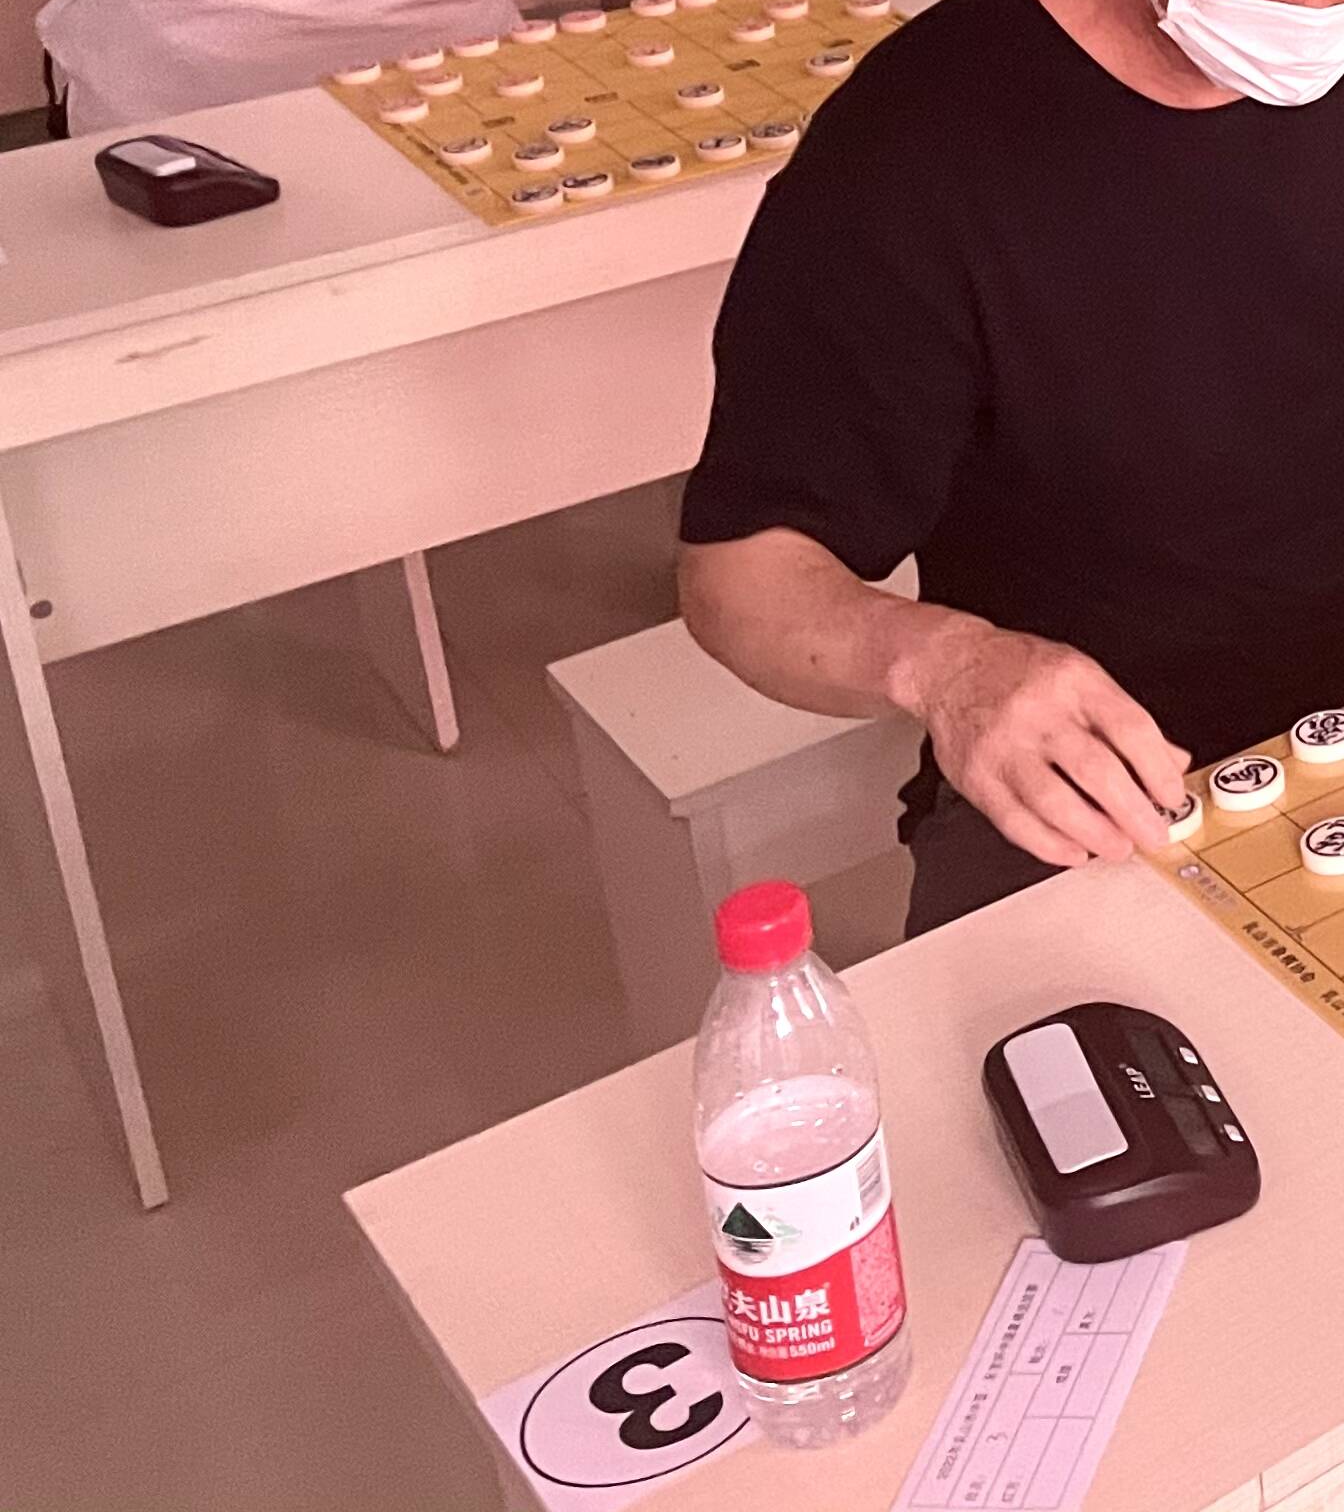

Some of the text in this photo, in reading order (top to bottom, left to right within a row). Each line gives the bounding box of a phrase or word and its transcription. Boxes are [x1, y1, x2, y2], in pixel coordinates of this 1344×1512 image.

[722, 1285, 831, 1325] 夫山泉
[765, 1319, 833, 1345] SPRING
[589, 1341, 724, 1451] 3
